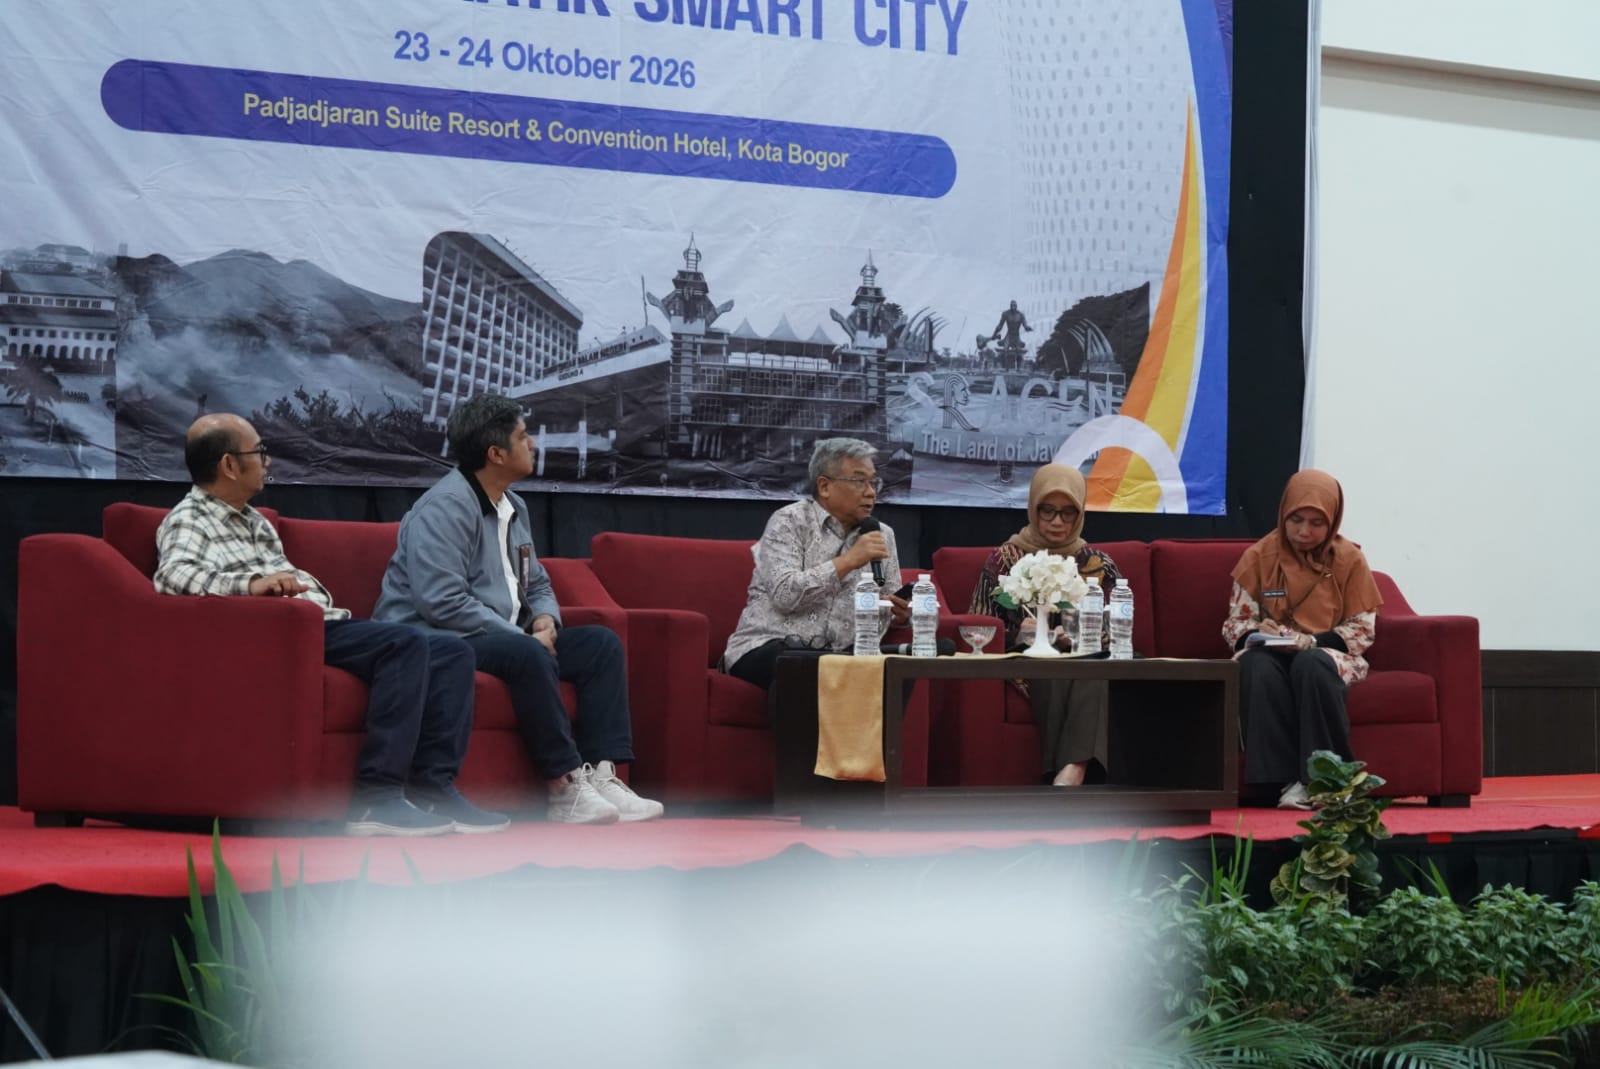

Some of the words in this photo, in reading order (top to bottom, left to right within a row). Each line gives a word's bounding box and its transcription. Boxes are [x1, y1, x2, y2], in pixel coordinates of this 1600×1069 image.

[854, 0, 968, 56] CITY
[393, 30, 430, 62] 23
[457, 37, 494, 69] 24
[502, 41, 622, 81] Oktober
[629, 55, 696, 89] 2026
[243, 93, 379, 128] Padjadjaran
[386, 106, 442, 132] Suite
[449, 112, 520, 139] Resort
[526, 120, 542, 141] &
[548, 121, 668, 152] Convention
[674, 133, 732, 161] Hotel,
[738, 138, 782, 162] Kota
[788, 144, 849, 171] Bogor
[921, 431, 949, 455] The
[956, 434, 998, 460] Land
[1005, 437, 1024, 460] of
